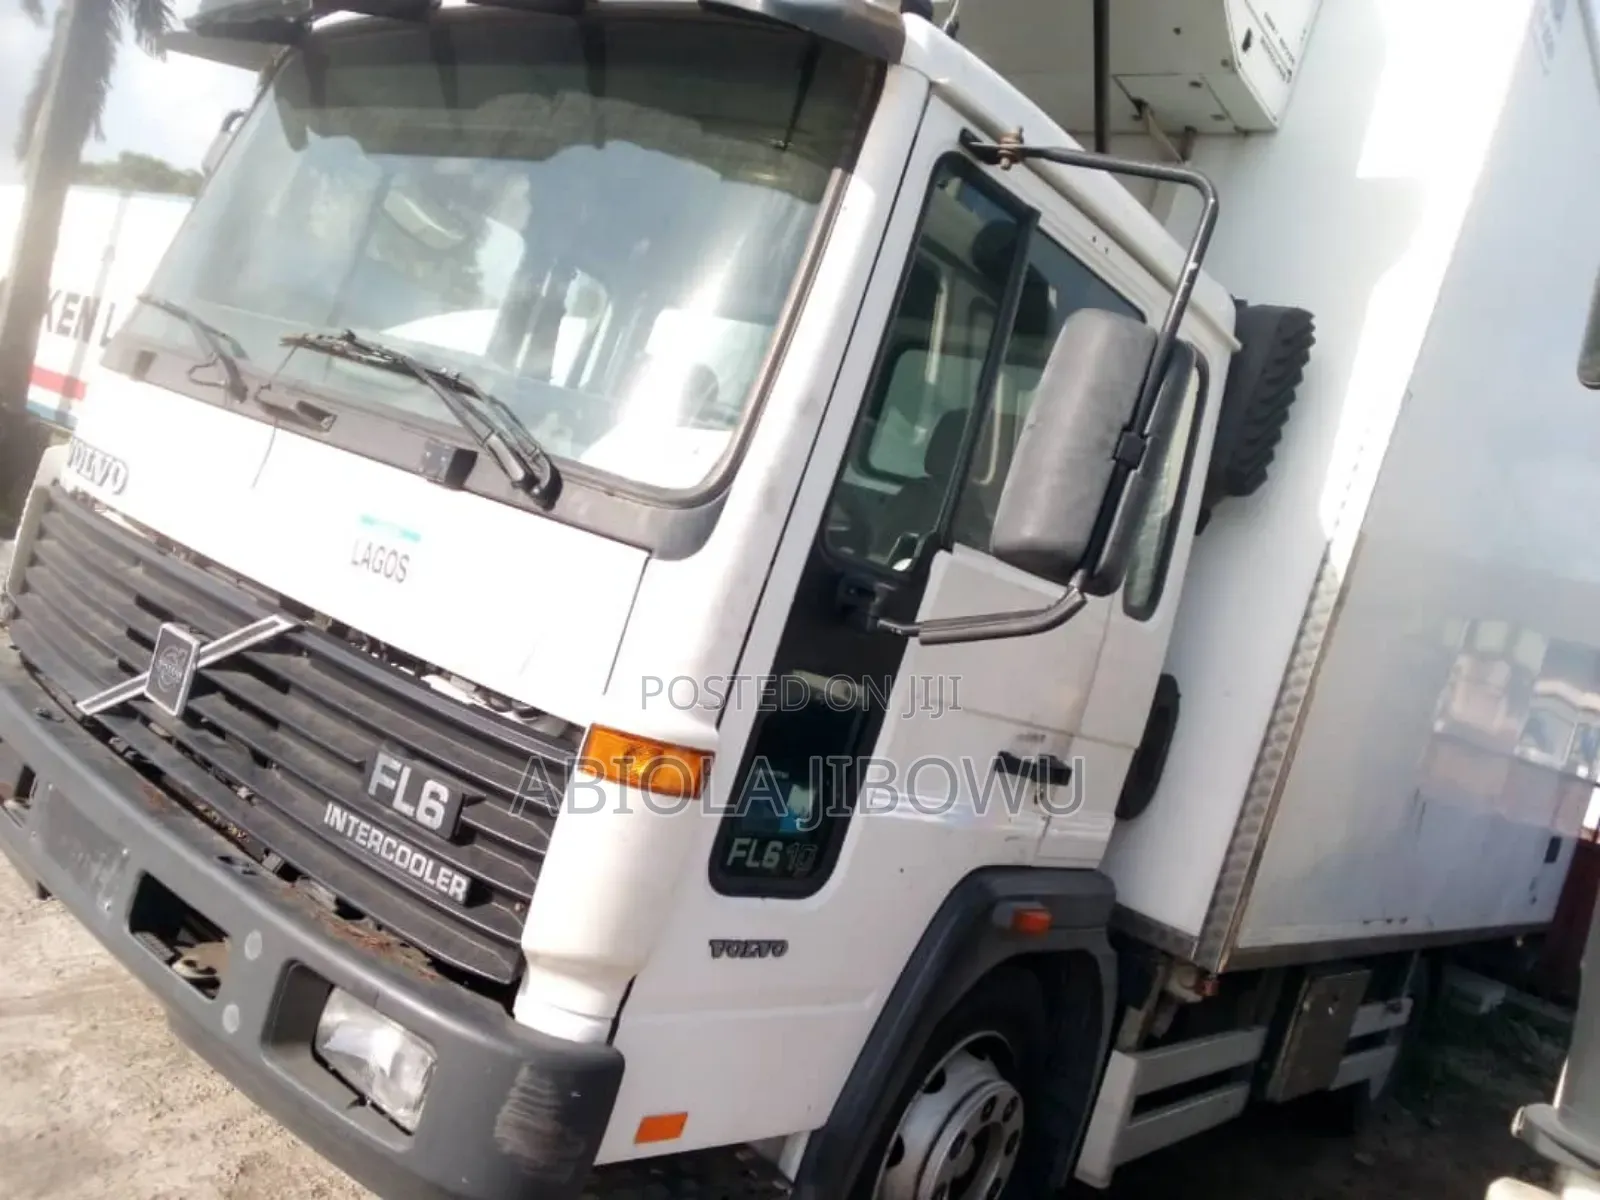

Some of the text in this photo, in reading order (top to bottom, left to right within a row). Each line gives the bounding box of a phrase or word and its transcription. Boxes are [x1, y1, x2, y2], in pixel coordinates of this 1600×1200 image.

[351, 538, 410, 584] LAGOS
[368, 751, 449, 831] FL6
[323, 801, 471, 904] INTERCOOLER
[709, 939, 789, 960] VOLVO
